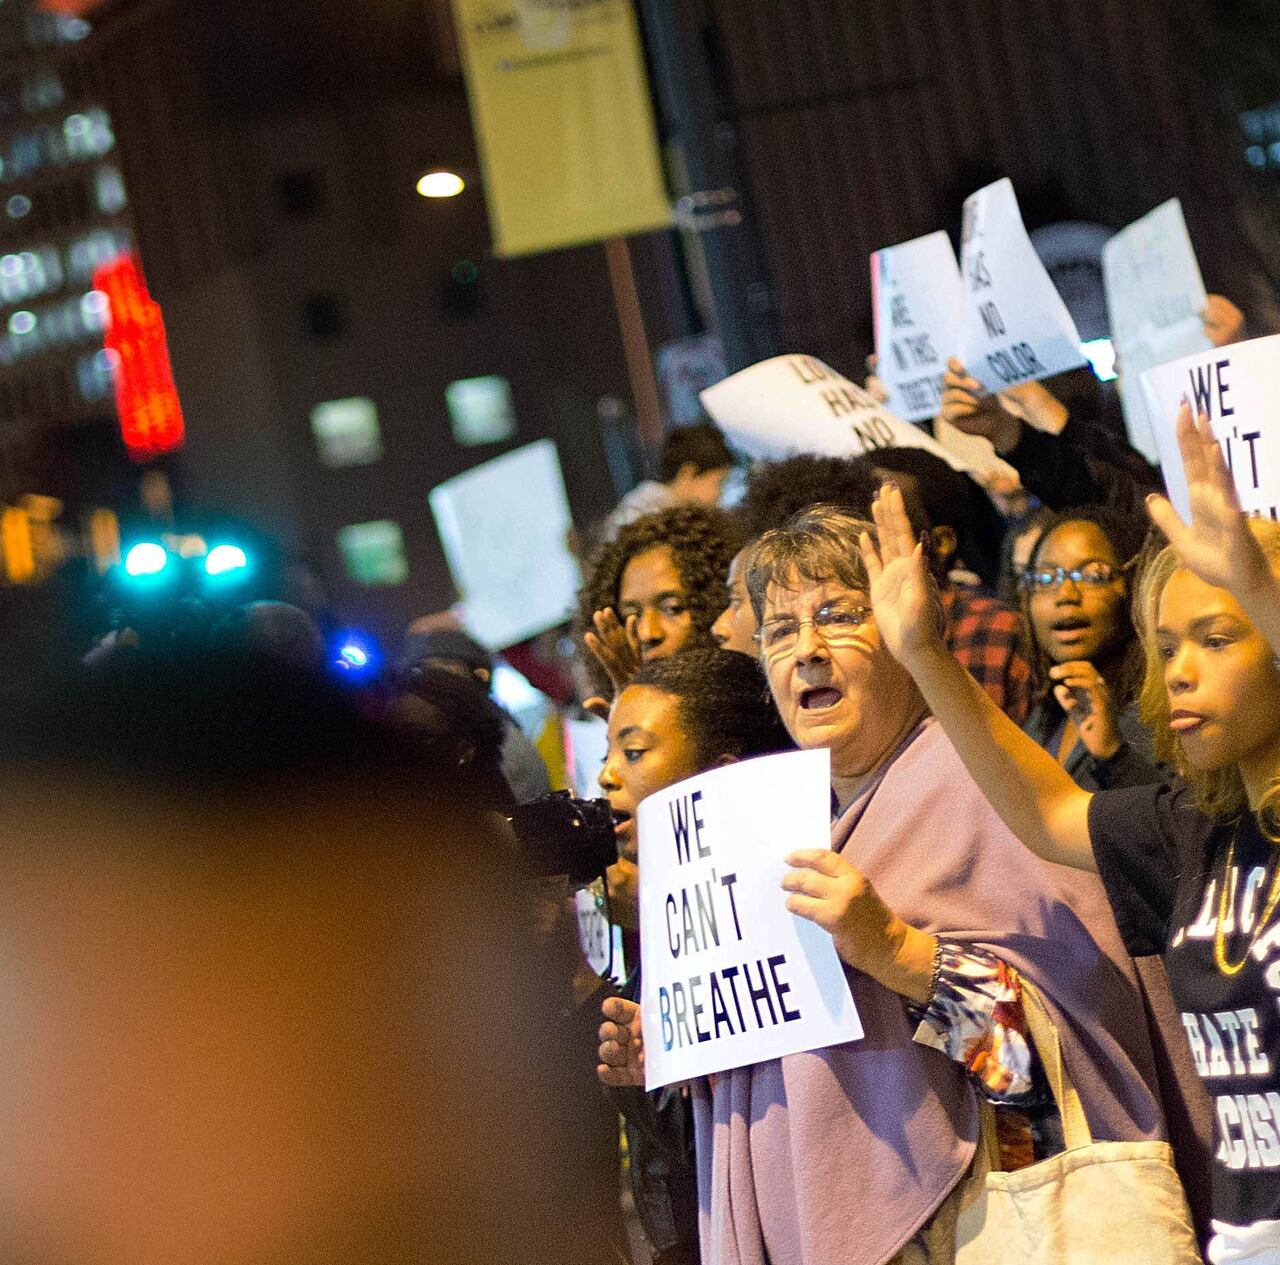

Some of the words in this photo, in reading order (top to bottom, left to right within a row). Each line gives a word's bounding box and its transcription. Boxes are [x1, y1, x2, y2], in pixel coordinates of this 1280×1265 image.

[979, 301, 1006, 338] NO
[986, 341, 1048, 384] COLOR
[1189, 358, 1235, 422] WE
[852, 416, 897, 451] NO
[669, 790, 712, 866] WE
[665, 868, 743, 960] CAN'T
[659, 953, 802, 1052] BREATHE
